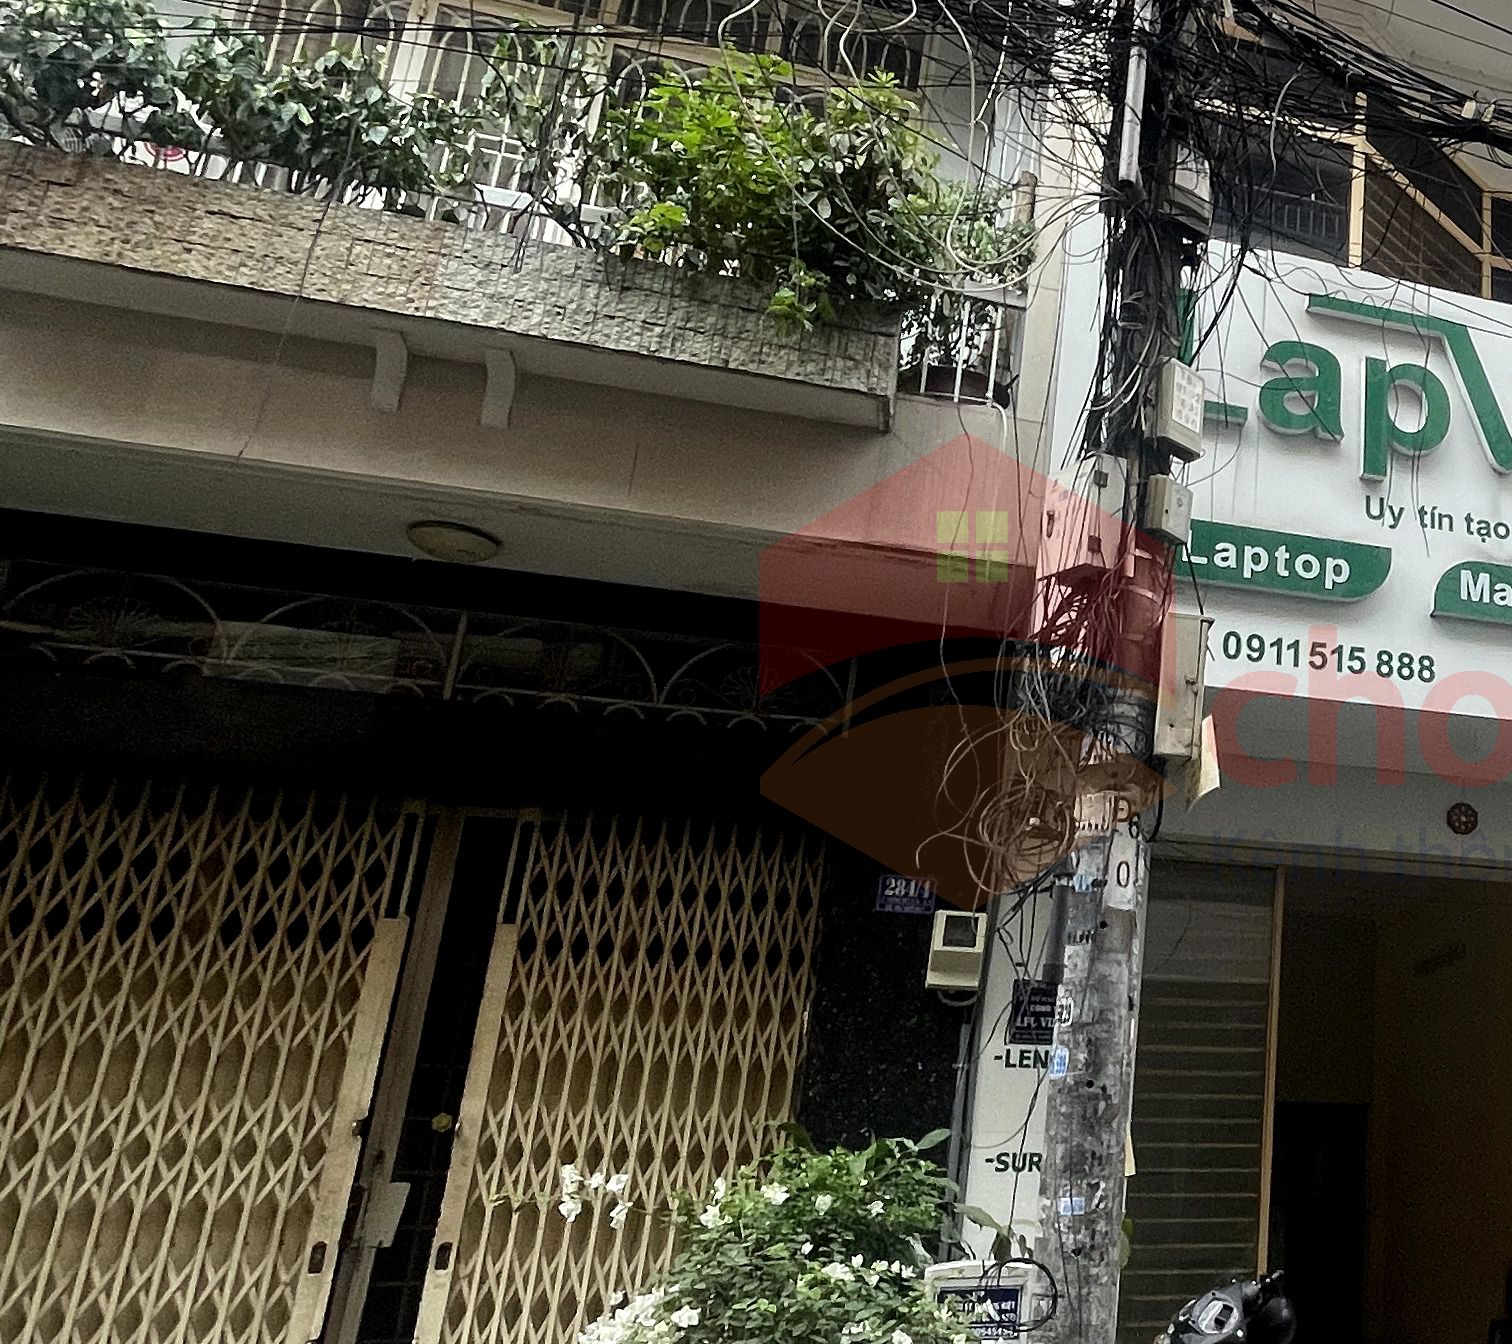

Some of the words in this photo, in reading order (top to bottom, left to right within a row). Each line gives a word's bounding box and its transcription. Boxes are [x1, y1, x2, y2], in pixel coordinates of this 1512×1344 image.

[1417, 504, 1455, 532] tín
[1464, 512, 1511, 544] tạo
[1181, 529, 1352, 590] Laptop
